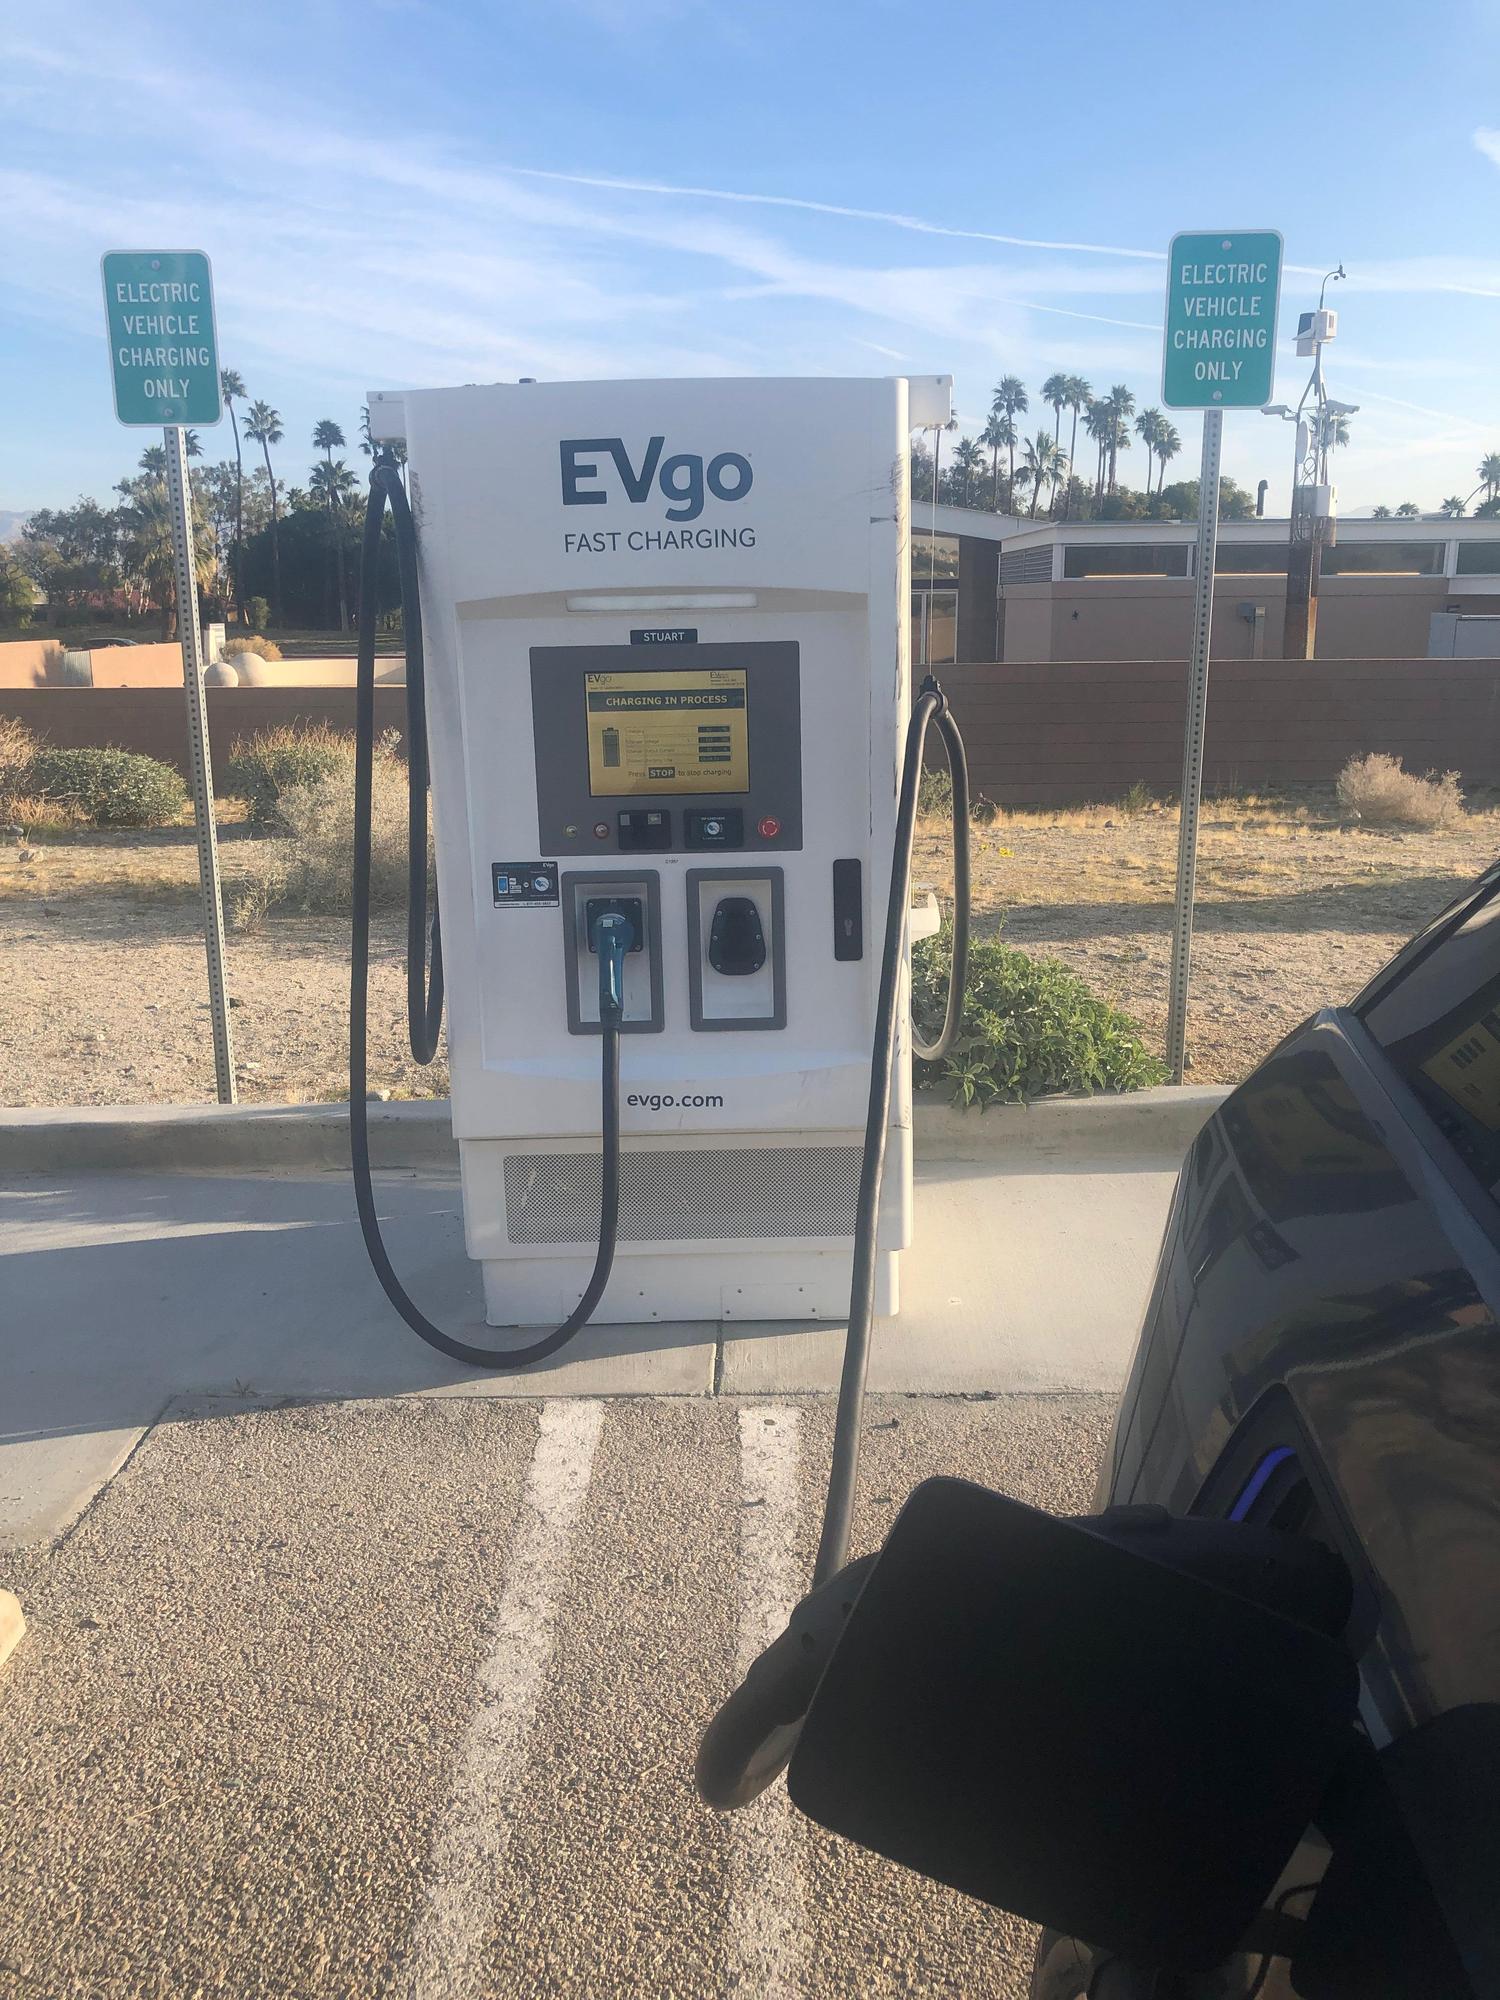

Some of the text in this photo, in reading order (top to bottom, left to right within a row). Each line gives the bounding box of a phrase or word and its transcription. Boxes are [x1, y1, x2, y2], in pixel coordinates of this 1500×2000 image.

[1181, 263, 1268, 285] ELECTRIC
[116, 283, 201, 303] ELECTRIC
[1184, 296, 1262, 317] VEHICLE
[123, 315, 200, 335] VEHICLE
[1174, 329, 1267, 349] CHARGING
[118, 347, 210, 367] CHARGING
[1194, 361, 1243, 381] ONLY
[143, 379, 190, 398] ONLY
[560, 436, 754, 522] EVgo
[564, 528, 756, 553] FAST CHARGING
[643, 631, 685, 642] STUART
[606, 695, 728, 706] CHARGING IN PROCESS
[649, 768, 674, 777] STOP
[678, 769, 686, 777] to
[703, 768, 732, 778] charging
[626, 1092, 724, 1111] evgo.com
